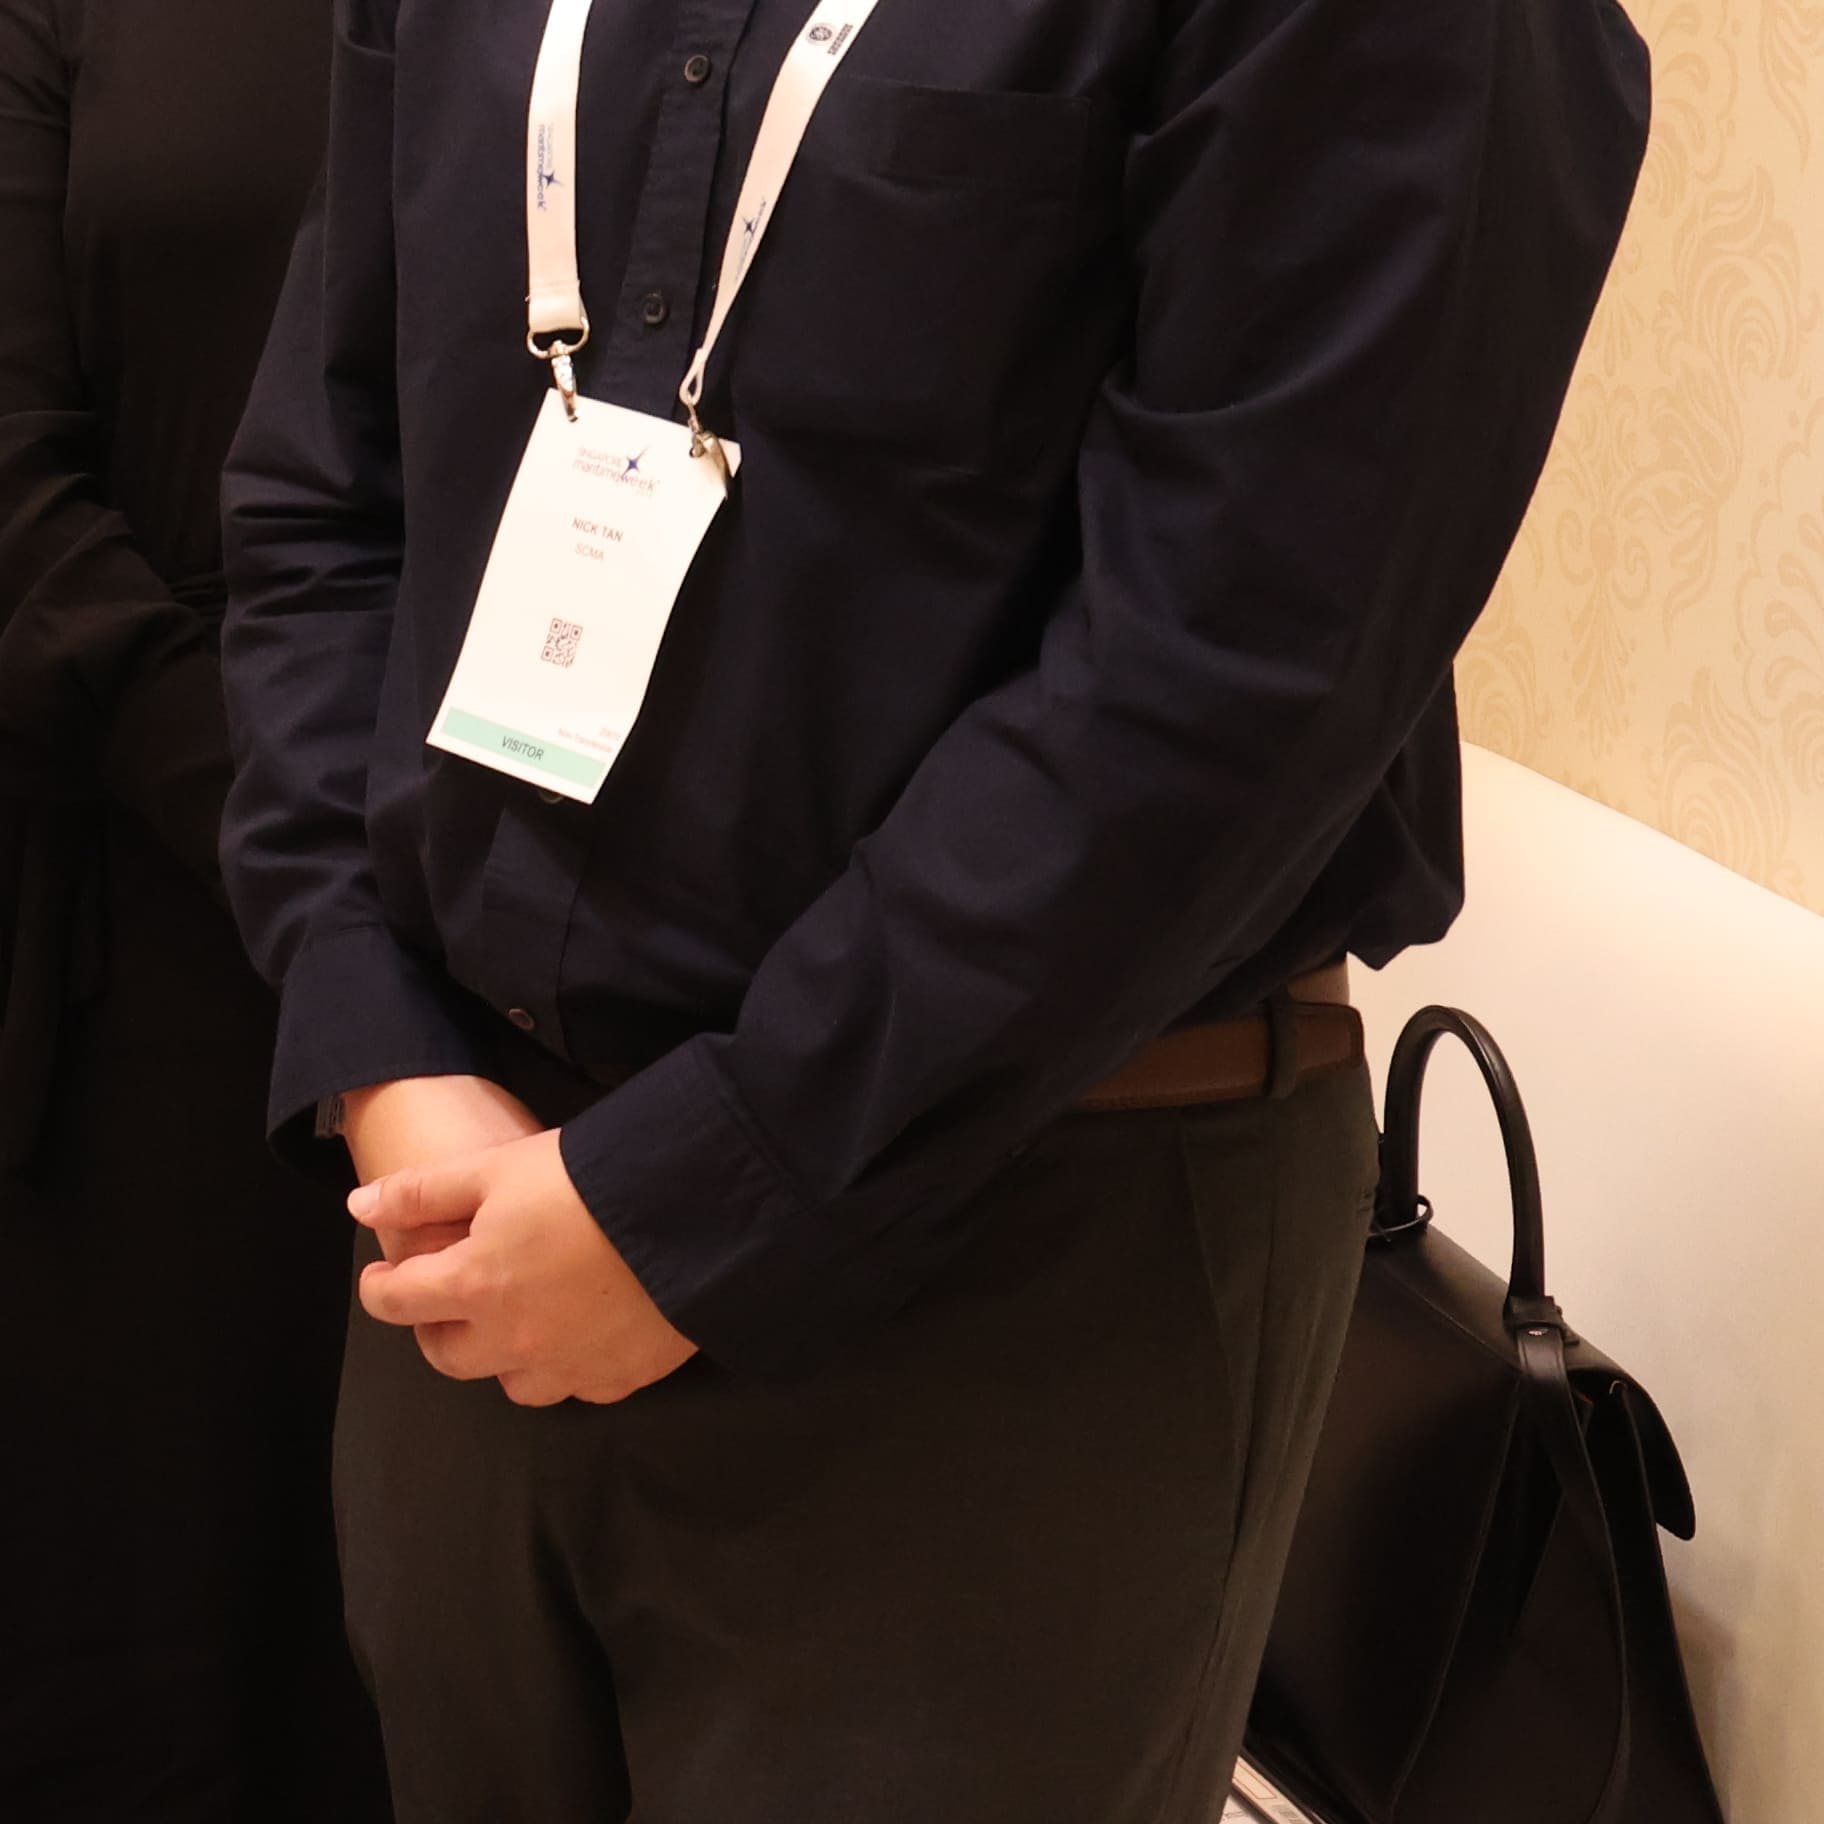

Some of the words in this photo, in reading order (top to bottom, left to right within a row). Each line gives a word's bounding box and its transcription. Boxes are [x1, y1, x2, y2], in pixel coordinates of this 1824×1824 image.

[572, 517, 598, 536] NICK
[601, 525, 623, 543] TAN
[501, 735, 544, 761] VISITOR
